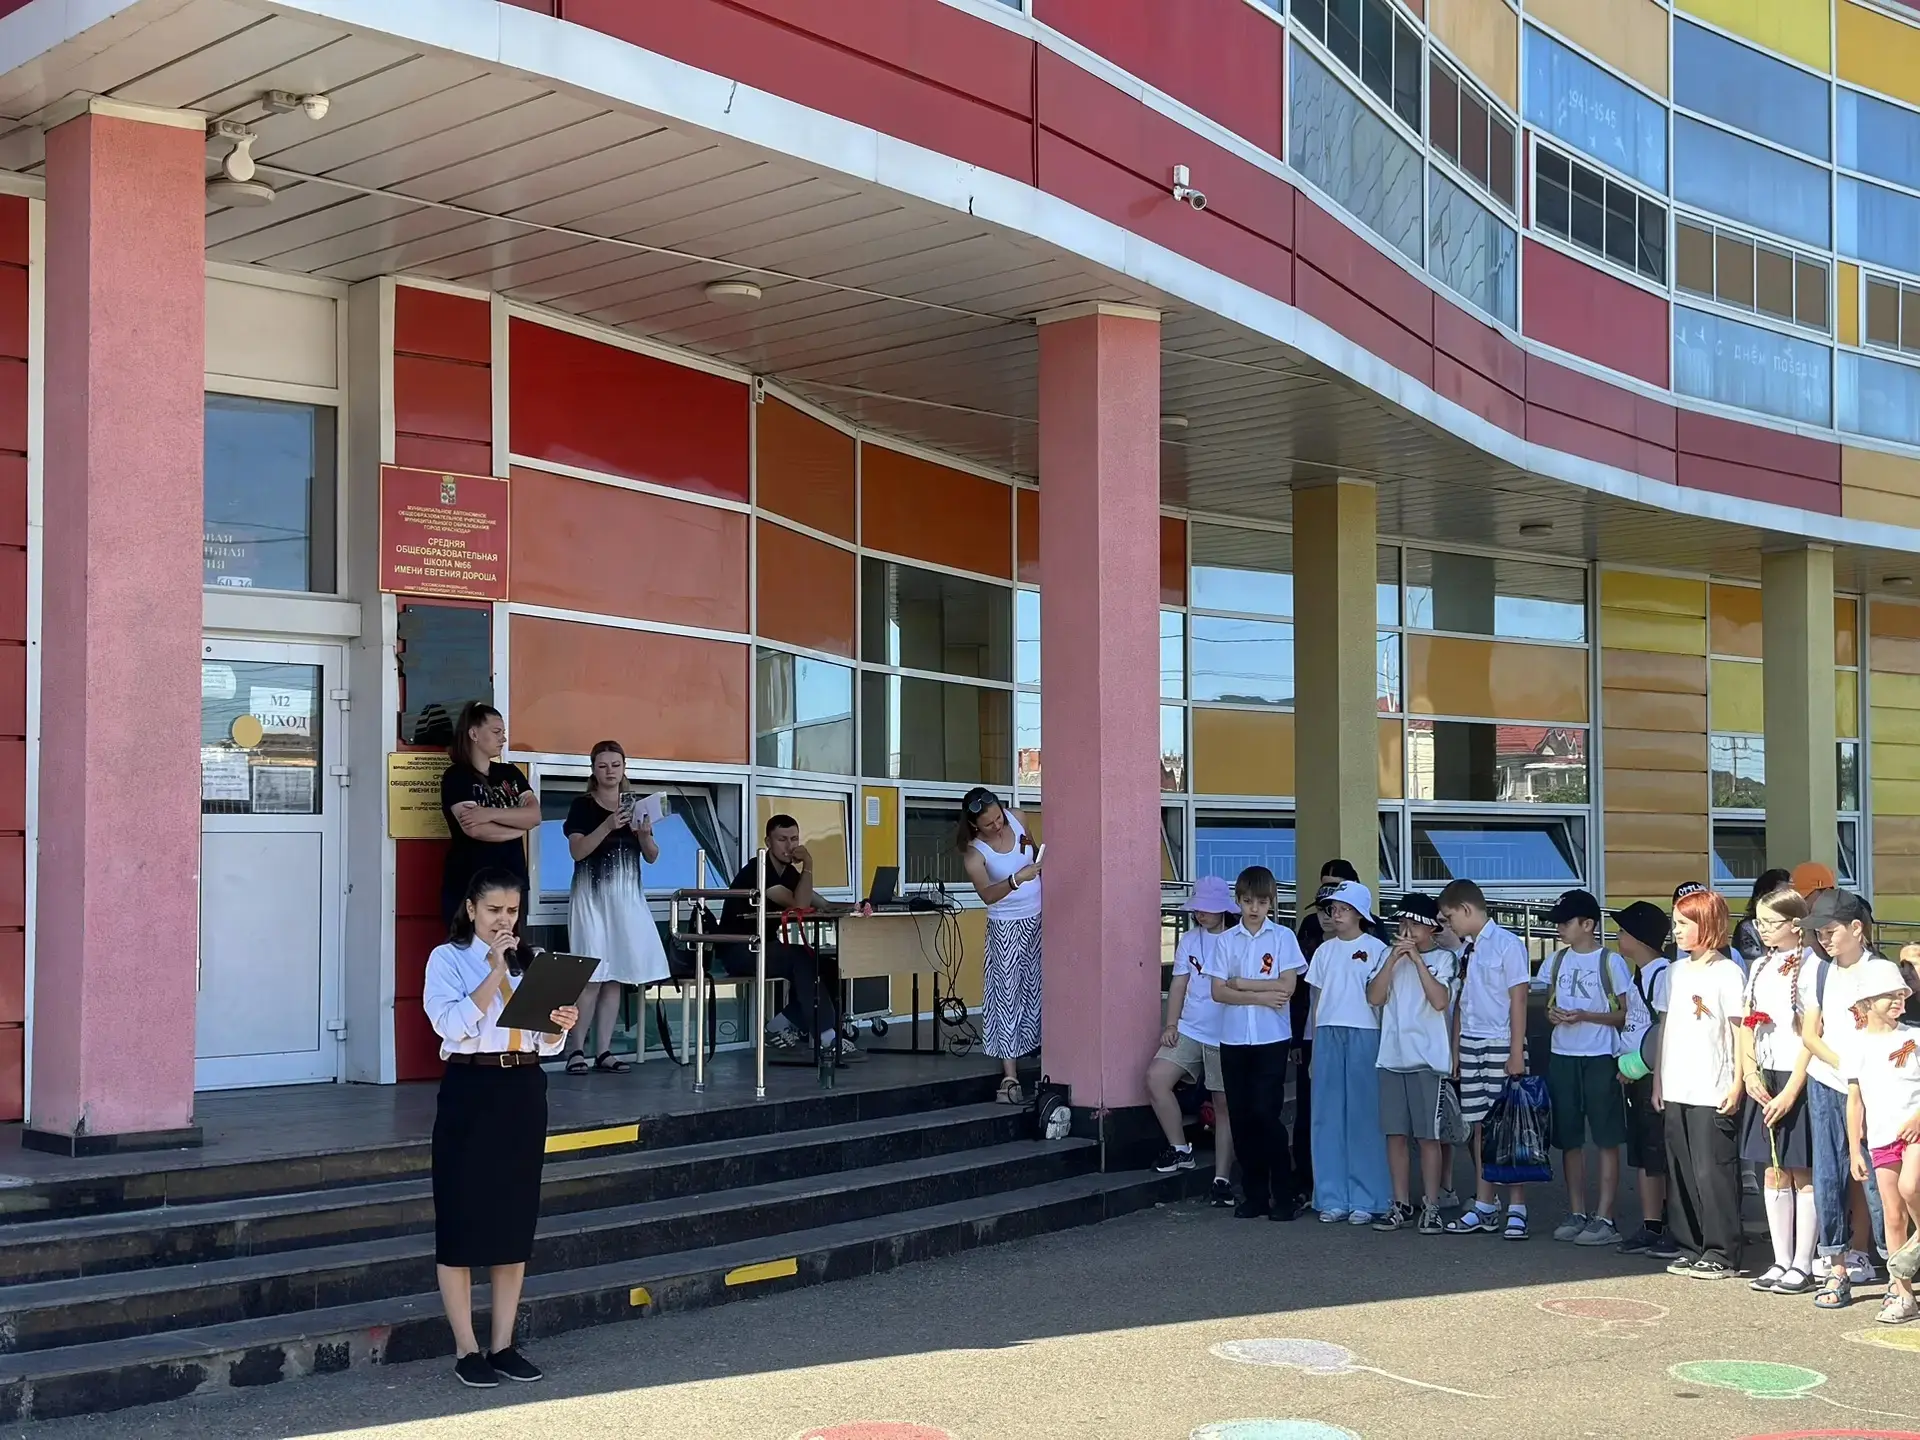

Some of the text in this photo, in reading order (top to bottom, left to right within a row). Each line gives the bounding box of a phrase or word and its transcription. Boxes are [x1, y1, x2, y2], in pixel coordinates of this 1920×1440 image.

[428, 537, 466, 549] СРЕДНЯЯ
[396, 544, 498, 562] ОБЩЕОБРАЗОВАТЕЛЬНАЯ
[423, 558, 472, 569] ШКОЛА №66
[394, 565, 497, 582] ИМЕНИ ЕВГЕНИЯ ДОРОША
[270, 696, 290, 707] М2
